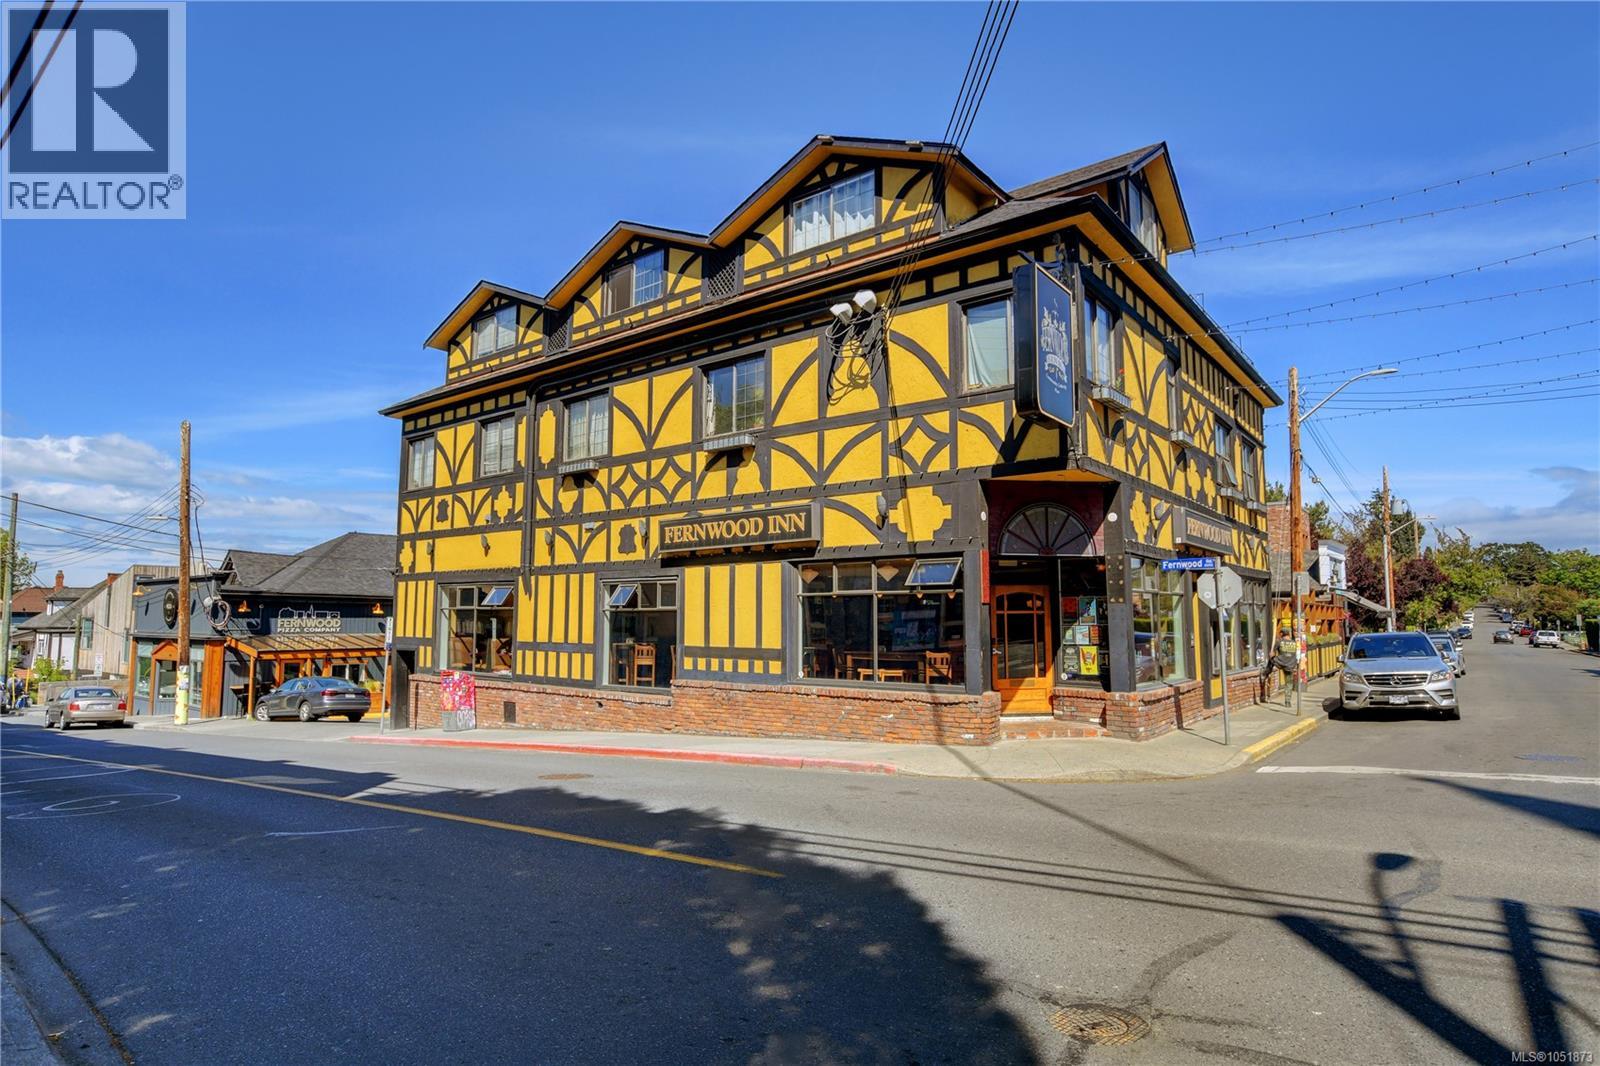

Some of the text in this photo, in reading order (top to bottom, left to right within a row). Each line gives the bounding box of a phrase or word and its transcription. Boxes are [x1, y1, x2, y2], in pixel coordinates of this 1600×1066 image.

[664, 512, 807, 544] FERNWOOD INN
[1187, 517, 1221, 544] FERNWOOD
[1162, 559, 1203, 570] Fernwood
[277, 618, 341, 628] FERNWOOD
